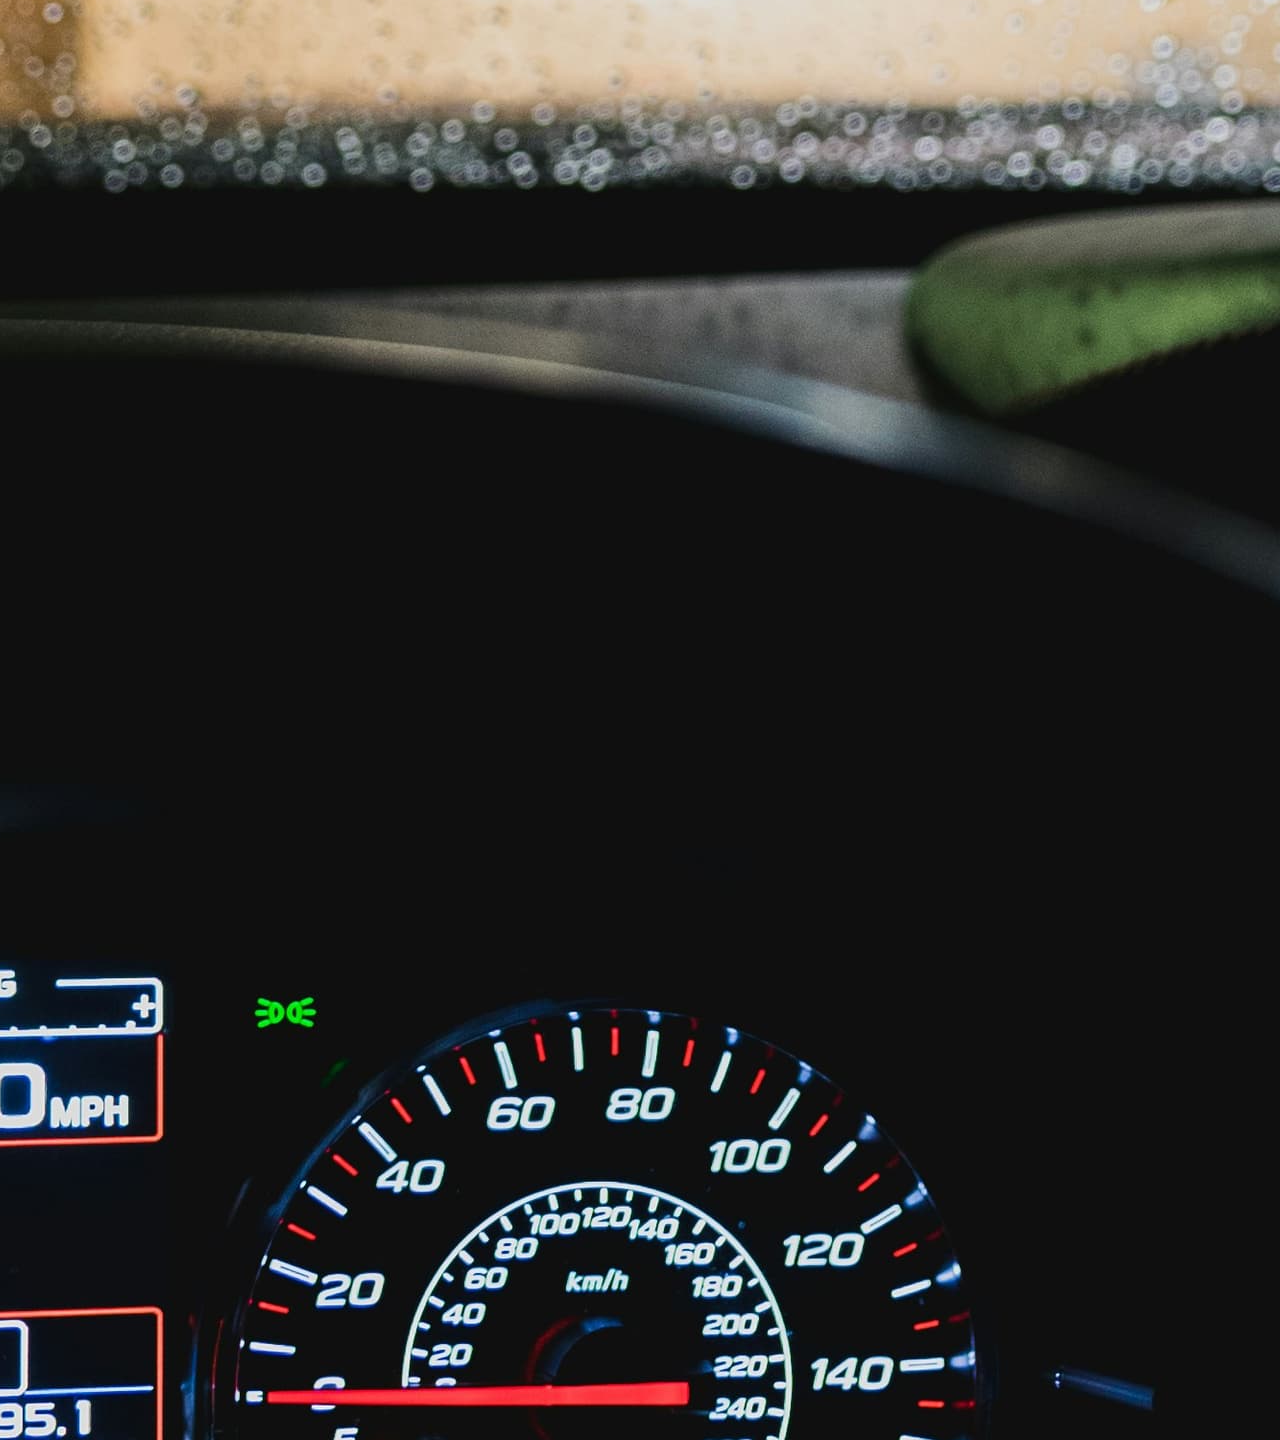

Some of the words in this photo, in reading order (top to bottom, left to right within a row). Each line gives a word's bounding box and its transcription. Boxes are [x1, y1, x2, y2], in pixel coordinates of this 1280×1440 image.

[50, 1095, 129, 1128] MPH
[487, 1096, 555, 1130] 60
[606, 1087, 675, 1120] 80
[710, 1139, 791, 1172] 100
[376, 1159, 445, 1193] 40
[528, 1212, 580, 1235] 100
[582, 1206, 630, 1228] 120
[628, 1216, 679, 1241] 140
[494, 1237, 538, 1259] 80
[665, 1242, 716, 1265] 160
[784, 1233, 865, 1266] 120
[317, 1273, 384, 1307] 20
[464, 1267, 508, 1289] 60
[566, 1268, 629, 1292] km/h
[692, 1273, 742, 1297] 180
[441, 1301, 486, 1325] 40
[703, 1313, 759, 1335] 200
[429, 1344, 473, 1366] 20
[713, 1355, 767, 1376] 220
[811, 1356, 894, 1390] 140
[709, 1397, 767, 1420] 240
